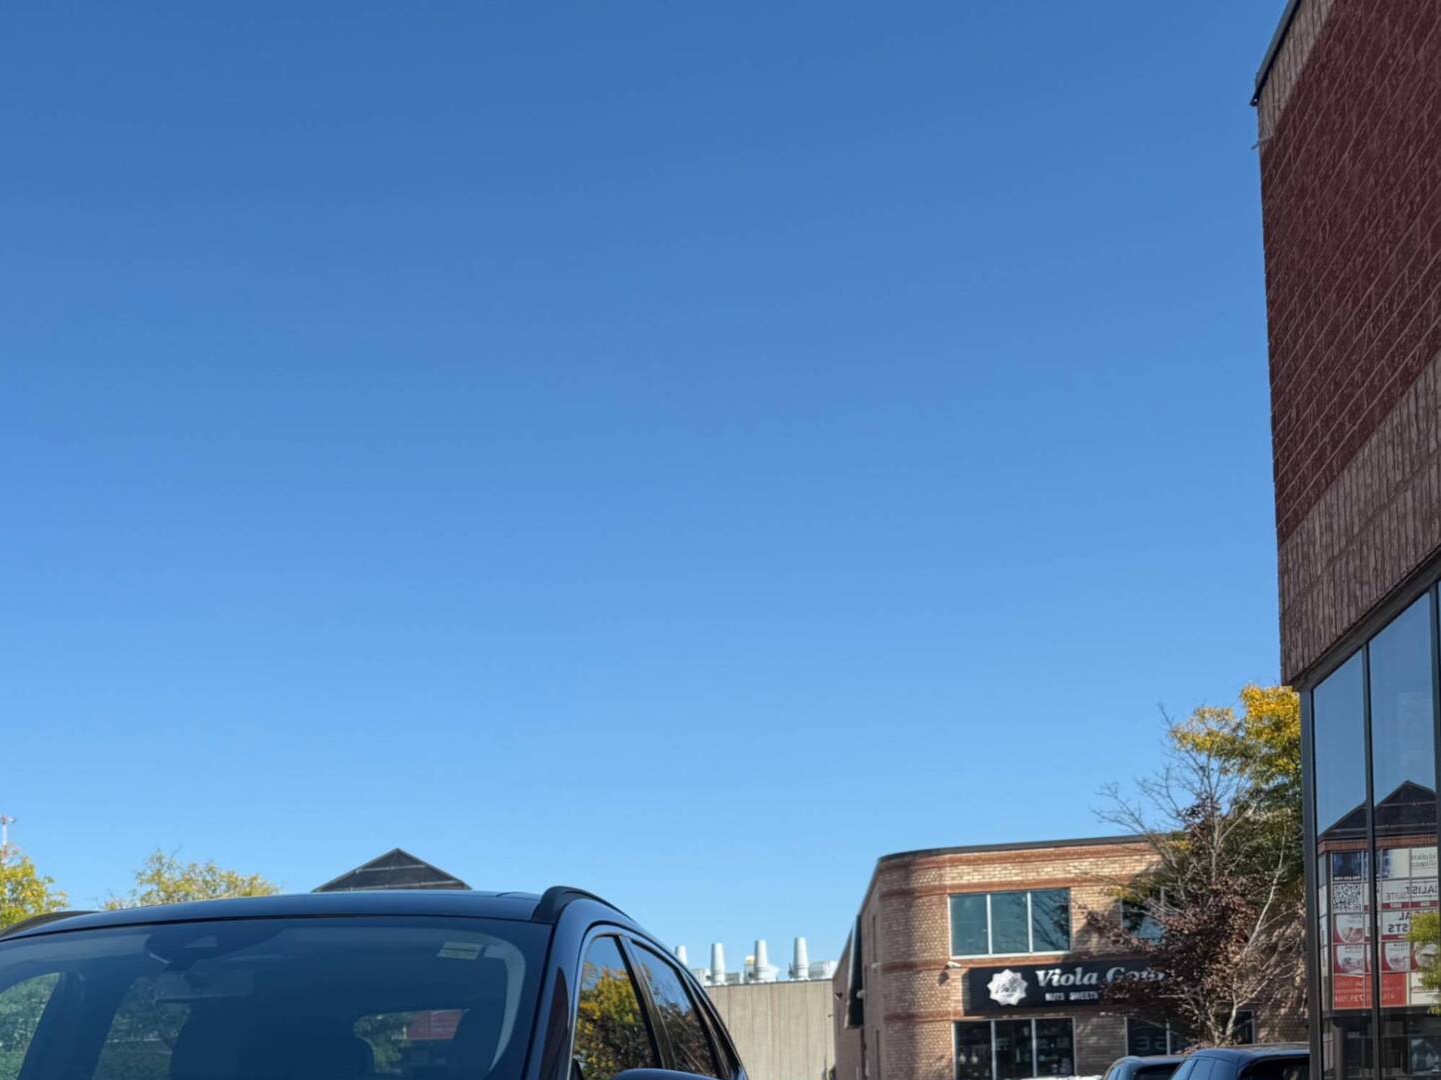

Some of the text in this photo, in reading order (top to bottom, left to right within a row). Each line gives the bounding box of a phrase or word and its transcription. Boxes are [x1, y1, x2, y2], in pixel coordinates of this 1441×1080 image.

[1035, 967, 1099, 987] Viola
[1045, 991, 1099, 1001] NUTS SWEETS
